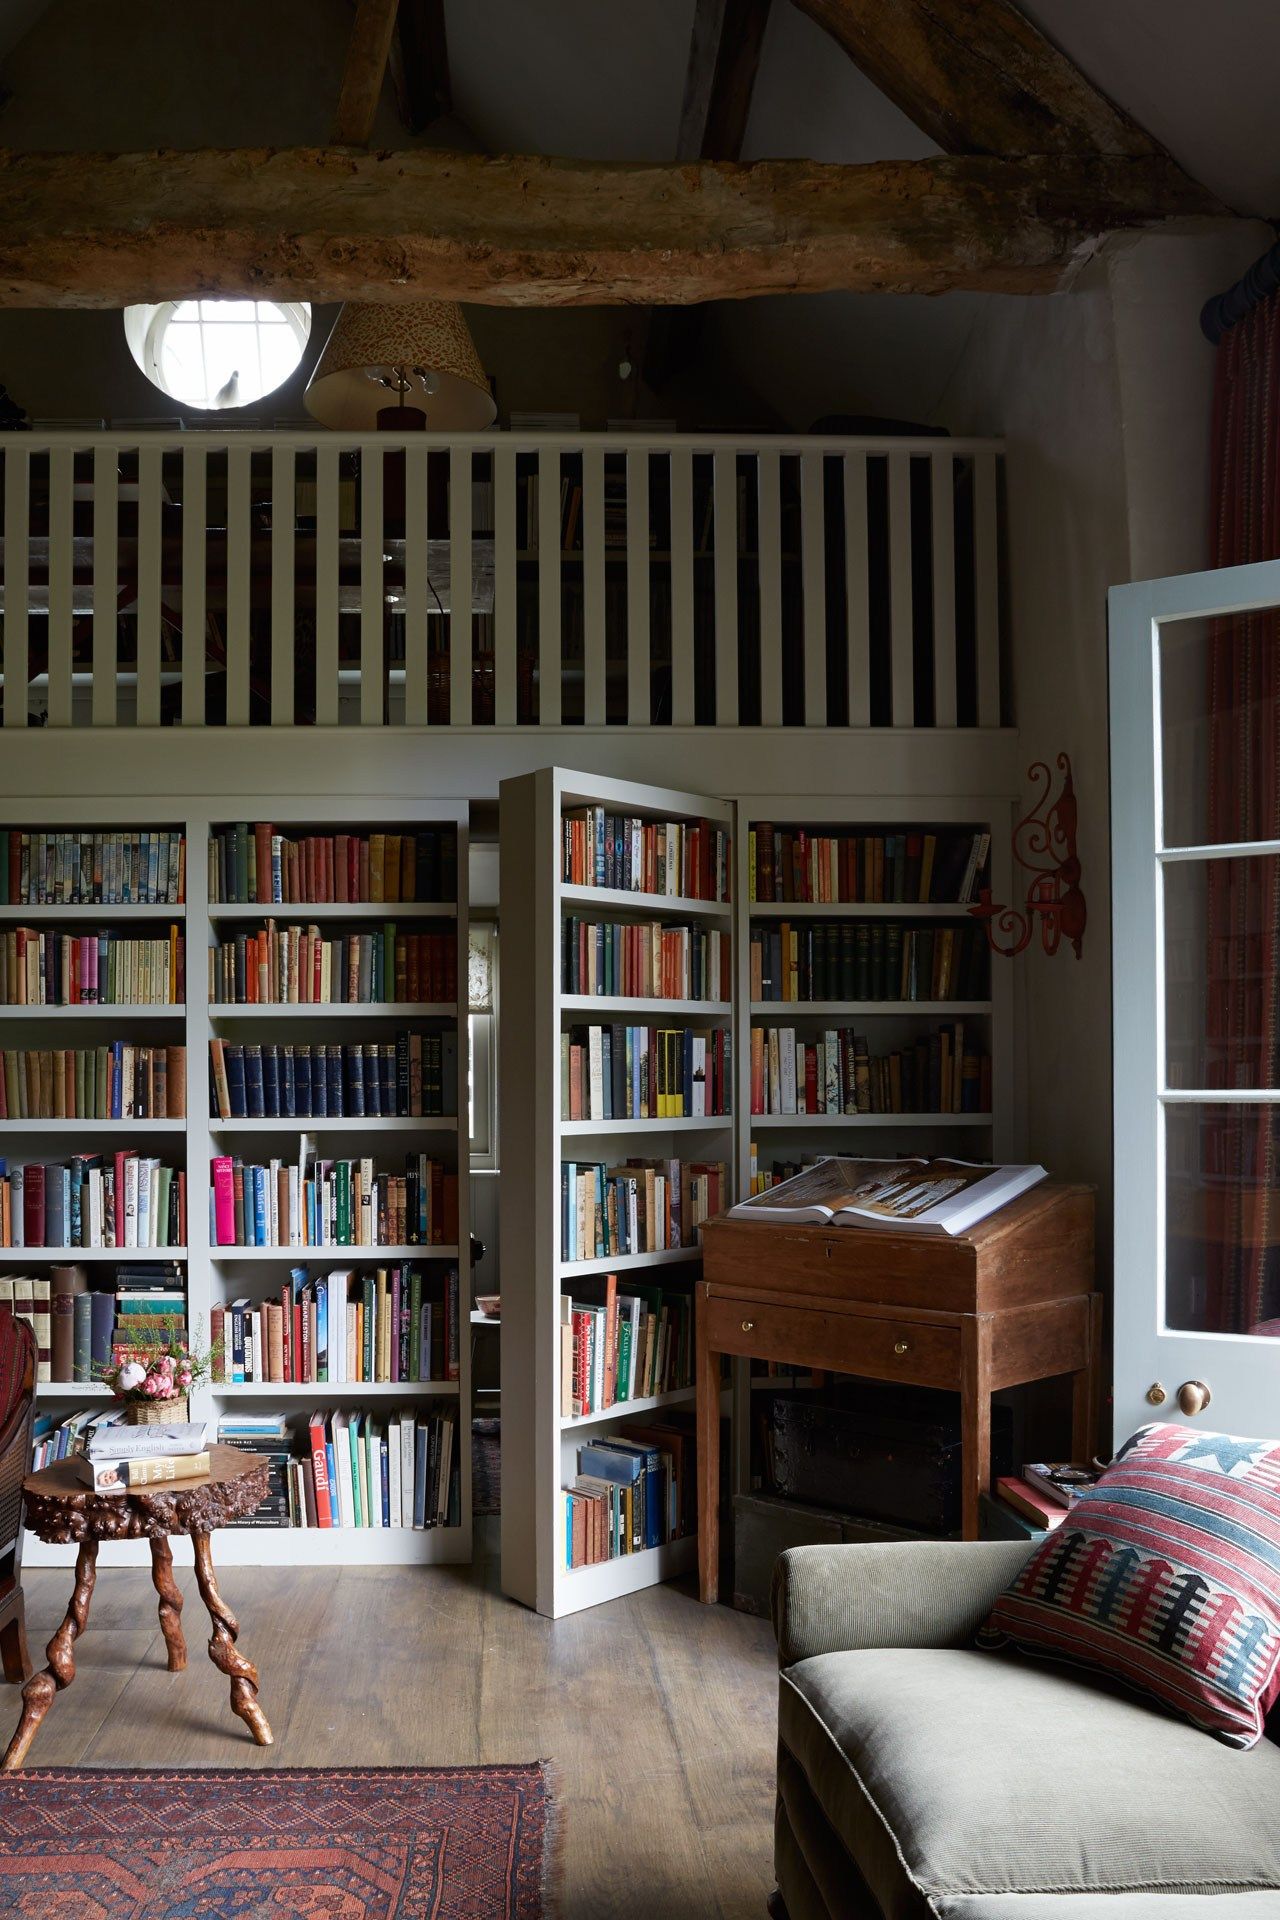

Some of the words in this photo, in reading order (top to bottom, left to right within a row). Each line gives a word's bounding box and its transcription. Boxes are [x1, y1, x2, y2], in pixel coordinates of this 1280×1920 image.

[127, 1165, 135, 1186] Kipling
[256, 1169, 264, 1189] Nancy
[256, 1190, 264, 1214] Mitford
[622, 1328, 631, 1357] FOLLIES
[244, 1336, 253, 1373] QUOTATIONS
[152, 1462, 162, 1480] My
[166, 1459, 175, 1481] Life
[313, 1449, 329, 1491] Gaudí
